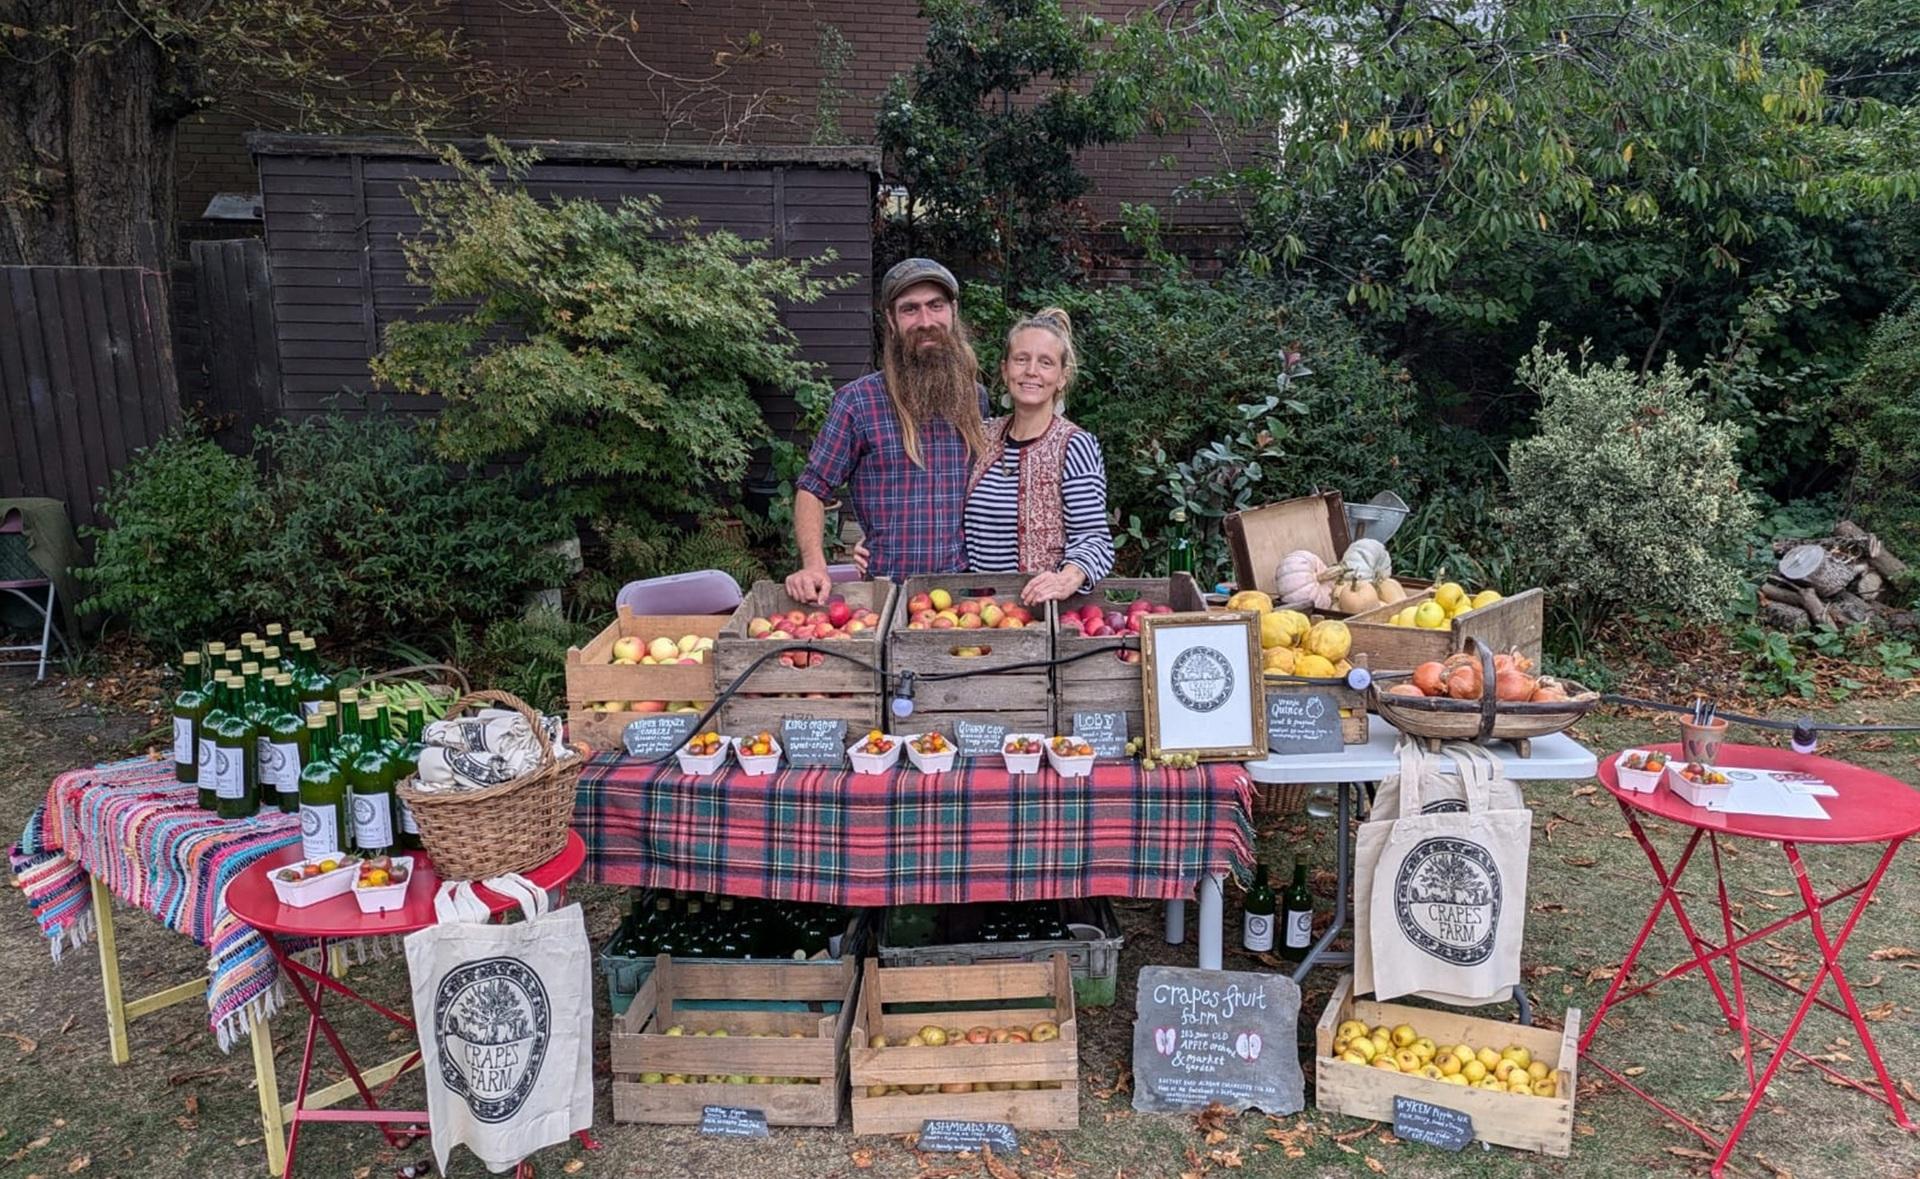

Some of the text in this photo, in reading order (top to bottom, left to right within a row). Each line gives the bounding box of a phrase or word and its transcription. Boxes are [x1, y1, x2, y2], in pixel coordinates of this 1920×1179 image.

[1272, 704, 1304, 718] Quince
[1428, 904, 1483, 925] CRAPES
[1439, 924, 1476, 942] FARM
[1154, 984, 1267, 1018] Crapes fruit
[1180, 1007, 1219, 1025] farm
[1180, 1040, 1209, 1050] APPLE
[1212, 1032, 1229, 1041] OLD
[464, 1043, 520, 1069] CRAPES
[1171, 1050, 1225, 1067] & market
[1185, 1064, 1216, 1074] garden
[470, 1067, 512, 1092] FARM
[1396, 1099, 1432, 1115] WYKEN
